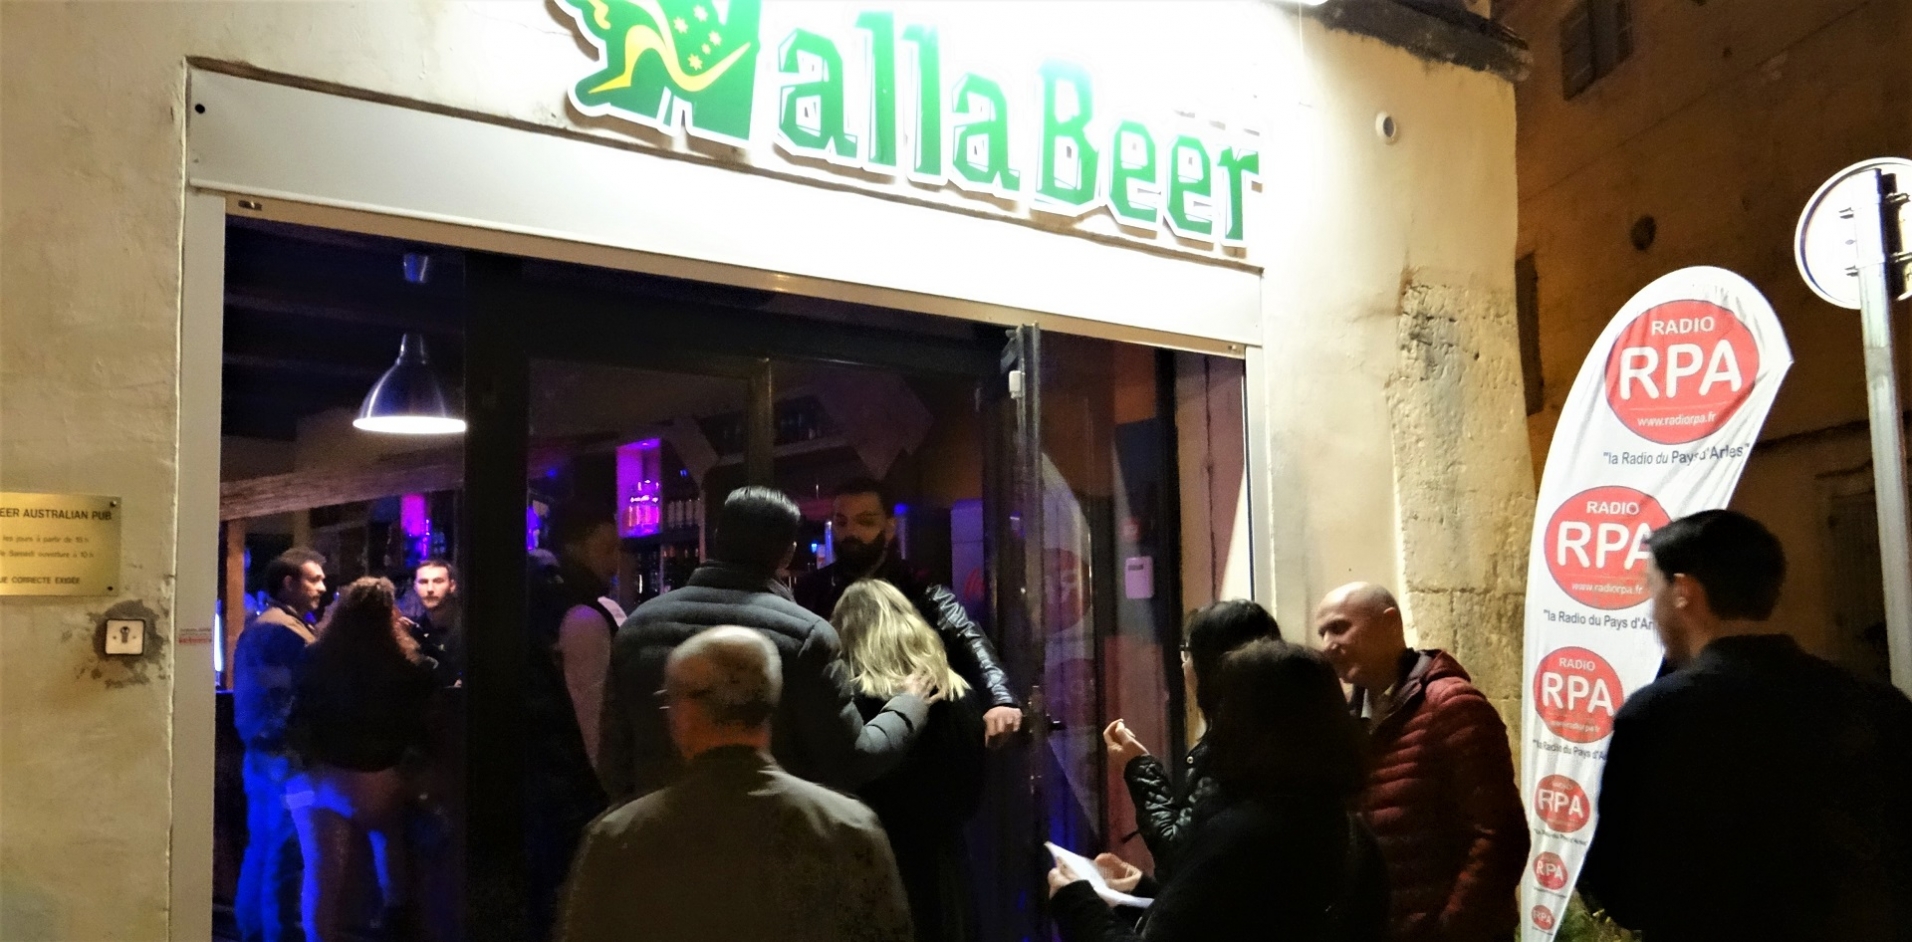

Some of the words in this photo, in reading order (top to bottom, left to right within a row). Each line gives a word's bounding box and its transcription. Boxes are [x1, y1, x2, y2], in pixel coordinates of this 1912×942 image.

[1036, 60, 1260, 241] Beer
[1651, 316, 1715, 336] RADIO
[1619, 339, 1742, 400] RPA
[1637, 412, 1717, 427] www.radiorpa.fr
[1622, 452, 1652, 464] Radio
[1655, 453, 1668, 464] du
[23, 508, 88, 520] AUSTRALIAN
[92, 510, 112, 521] PUB
[1586, 501, 1639, 515] RADIO
[1557, 521, 1652, 570] RPA
[11, 576, 51, 584] CORRECTE
[1572, 583, 1643, 595] www.radiorpa.fr
[1558, 611, 1586, 625] Radio
[1588, 614, 1602, 626] du
[1603, 615, 1628, 631] Pays
[1631, 618, 1653, 630] d'Ar
[1559, 657, 1596, 671] RADIO
[1541, 671, 1615, 717] RPA
[1538, 788, 1584, 818] RPA
[1536, 860, 1564, 881] RPA
